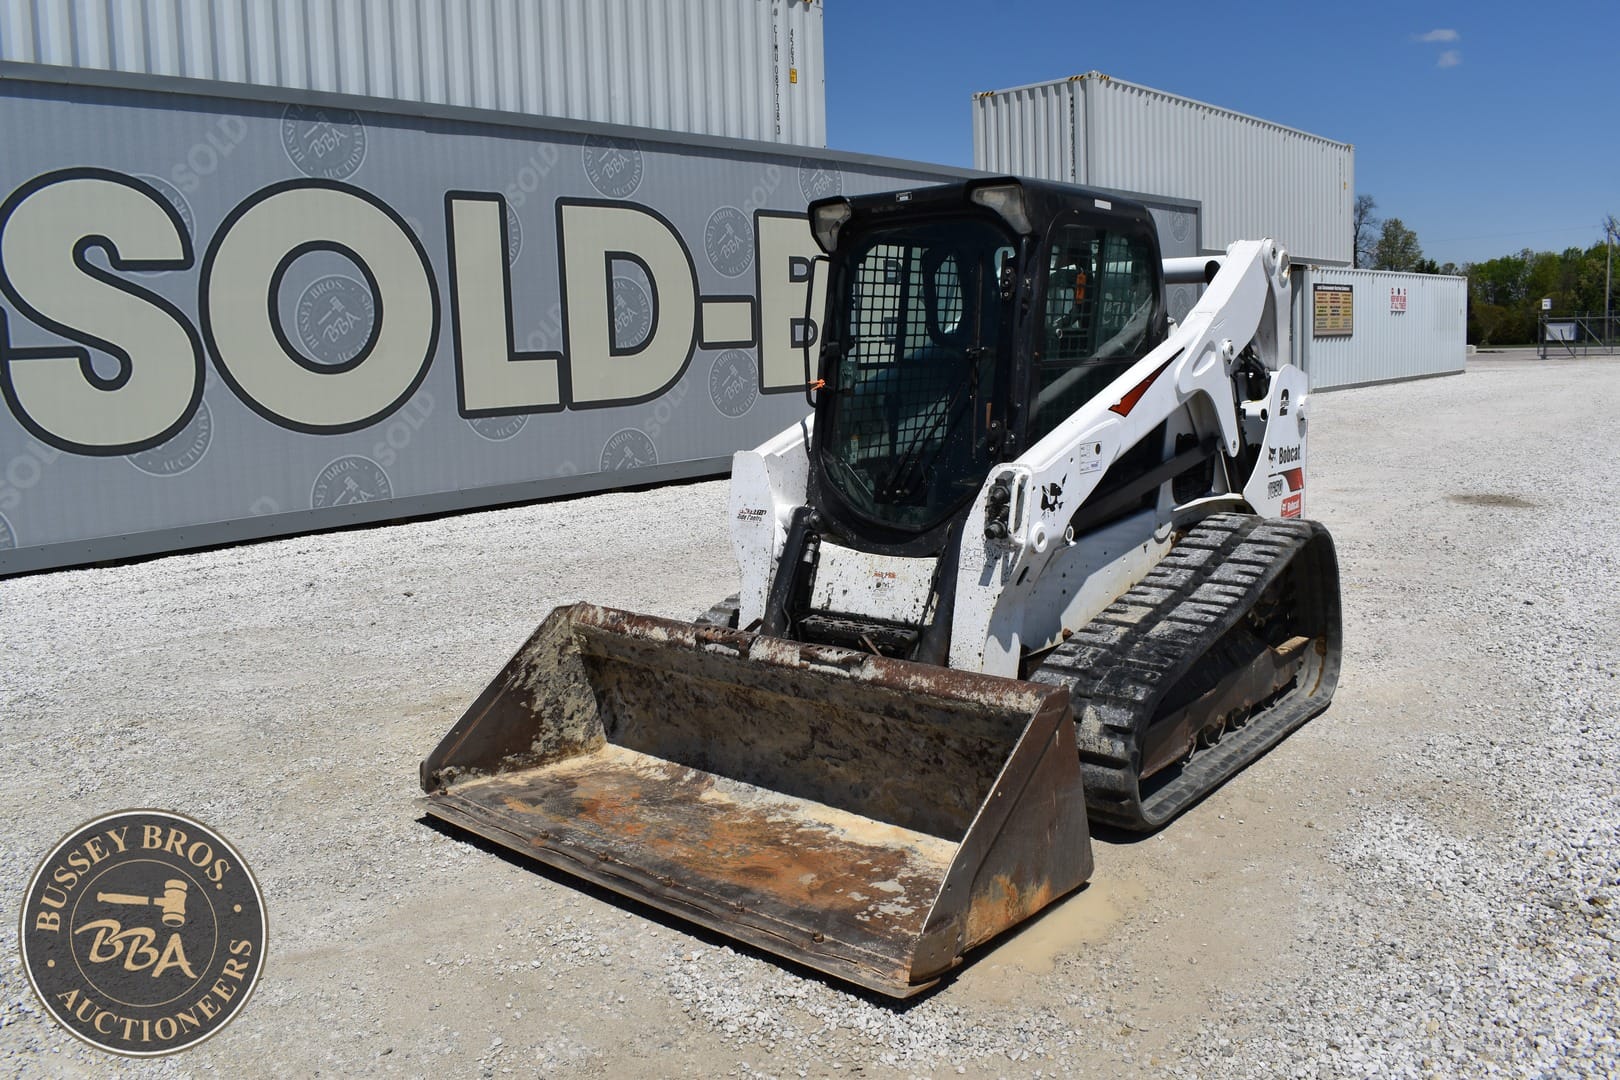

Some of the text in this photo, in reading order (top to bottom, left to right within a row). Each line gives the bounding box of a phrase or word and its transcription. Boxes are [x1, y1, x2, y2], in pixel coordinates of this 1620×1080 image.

[307, 127, 348, 159] BBA
[321, 311, 361, 343] BBA
[1279, 444, 1301, 465] Bobcat
